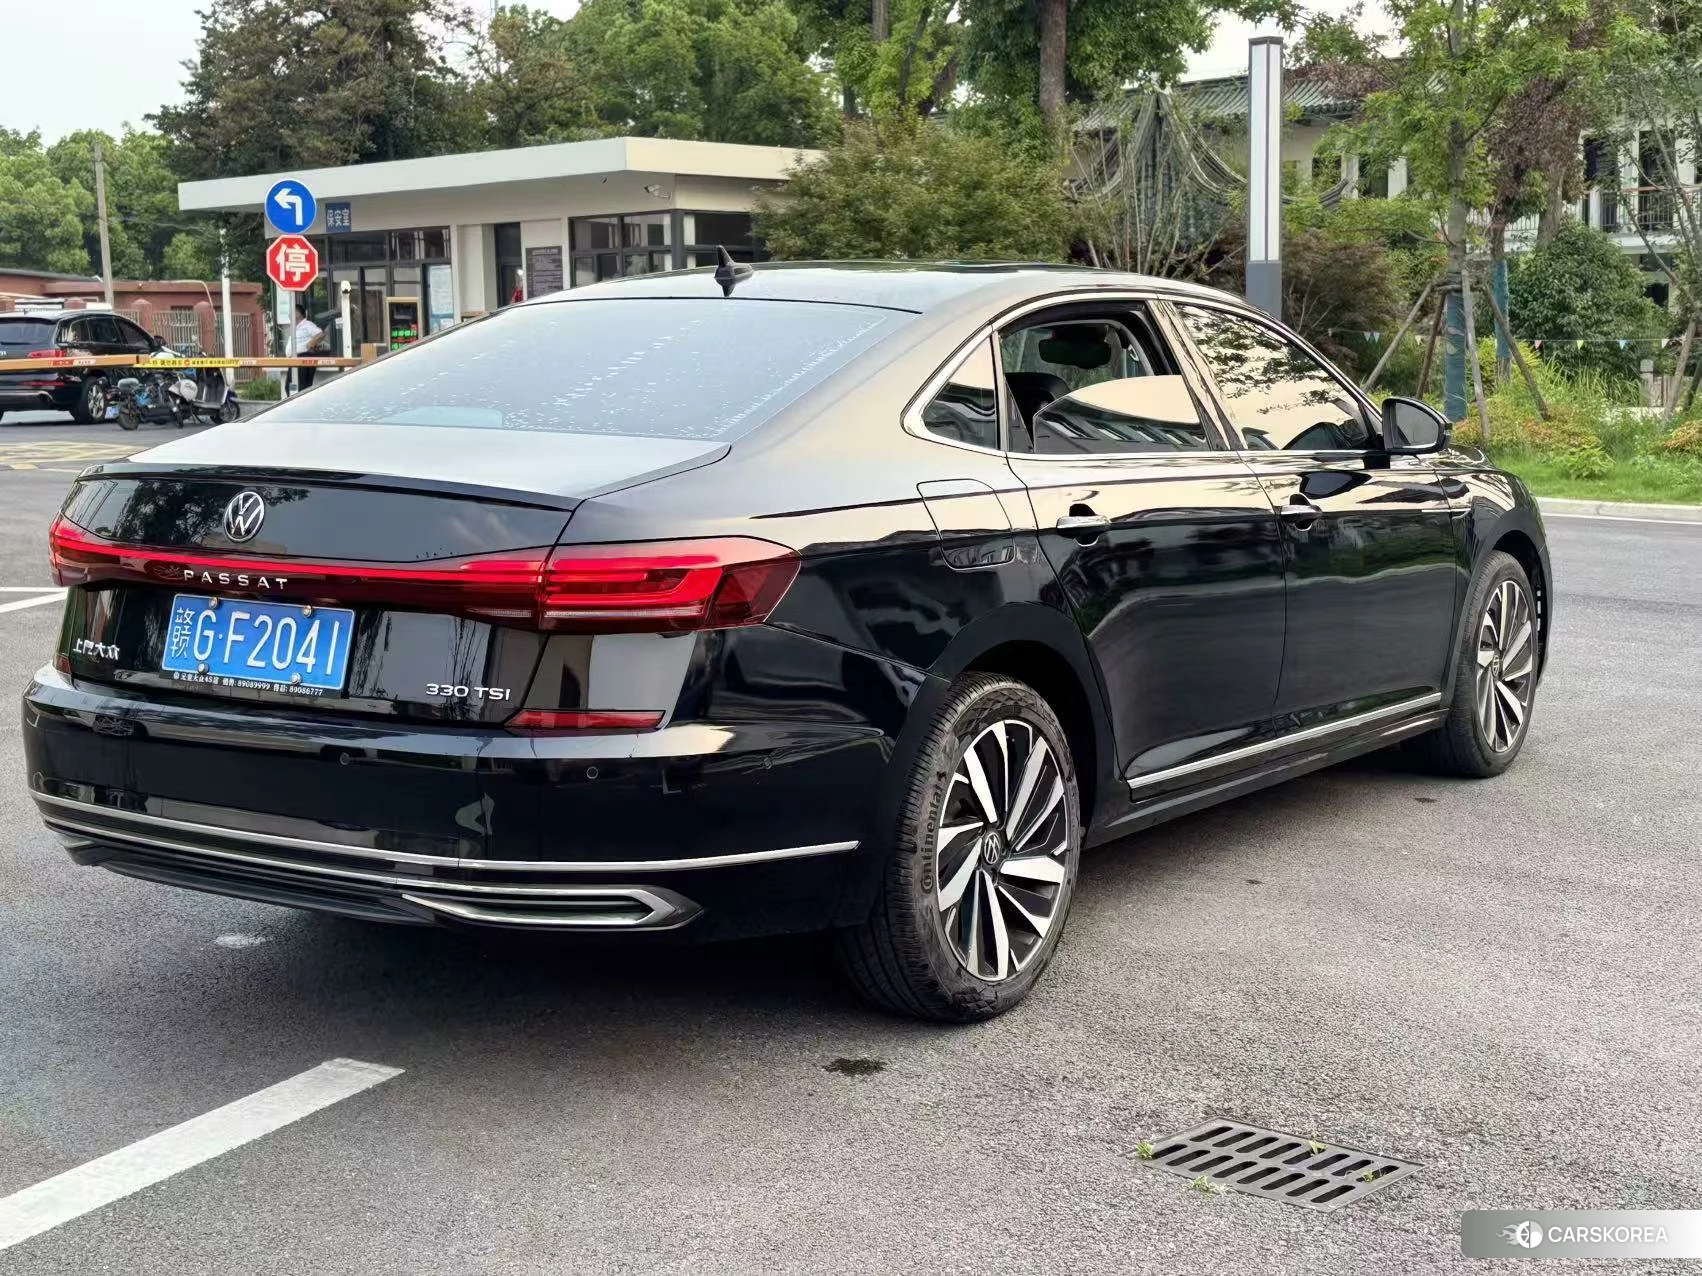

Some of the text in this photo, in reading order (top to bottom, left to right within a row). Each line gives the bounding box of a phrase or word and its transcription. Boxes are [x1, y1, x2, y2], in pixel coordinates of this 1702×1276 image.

[326, 208, 350, 227] 保安室
[275, 243, 311, 282] 停
[183, 569, 288, 590] PASSAT
[72, 638, 120, 660] 上汽大众
[425, 683, 511, 701] 330 TSI
[920, 783, 943, 894] Continental
